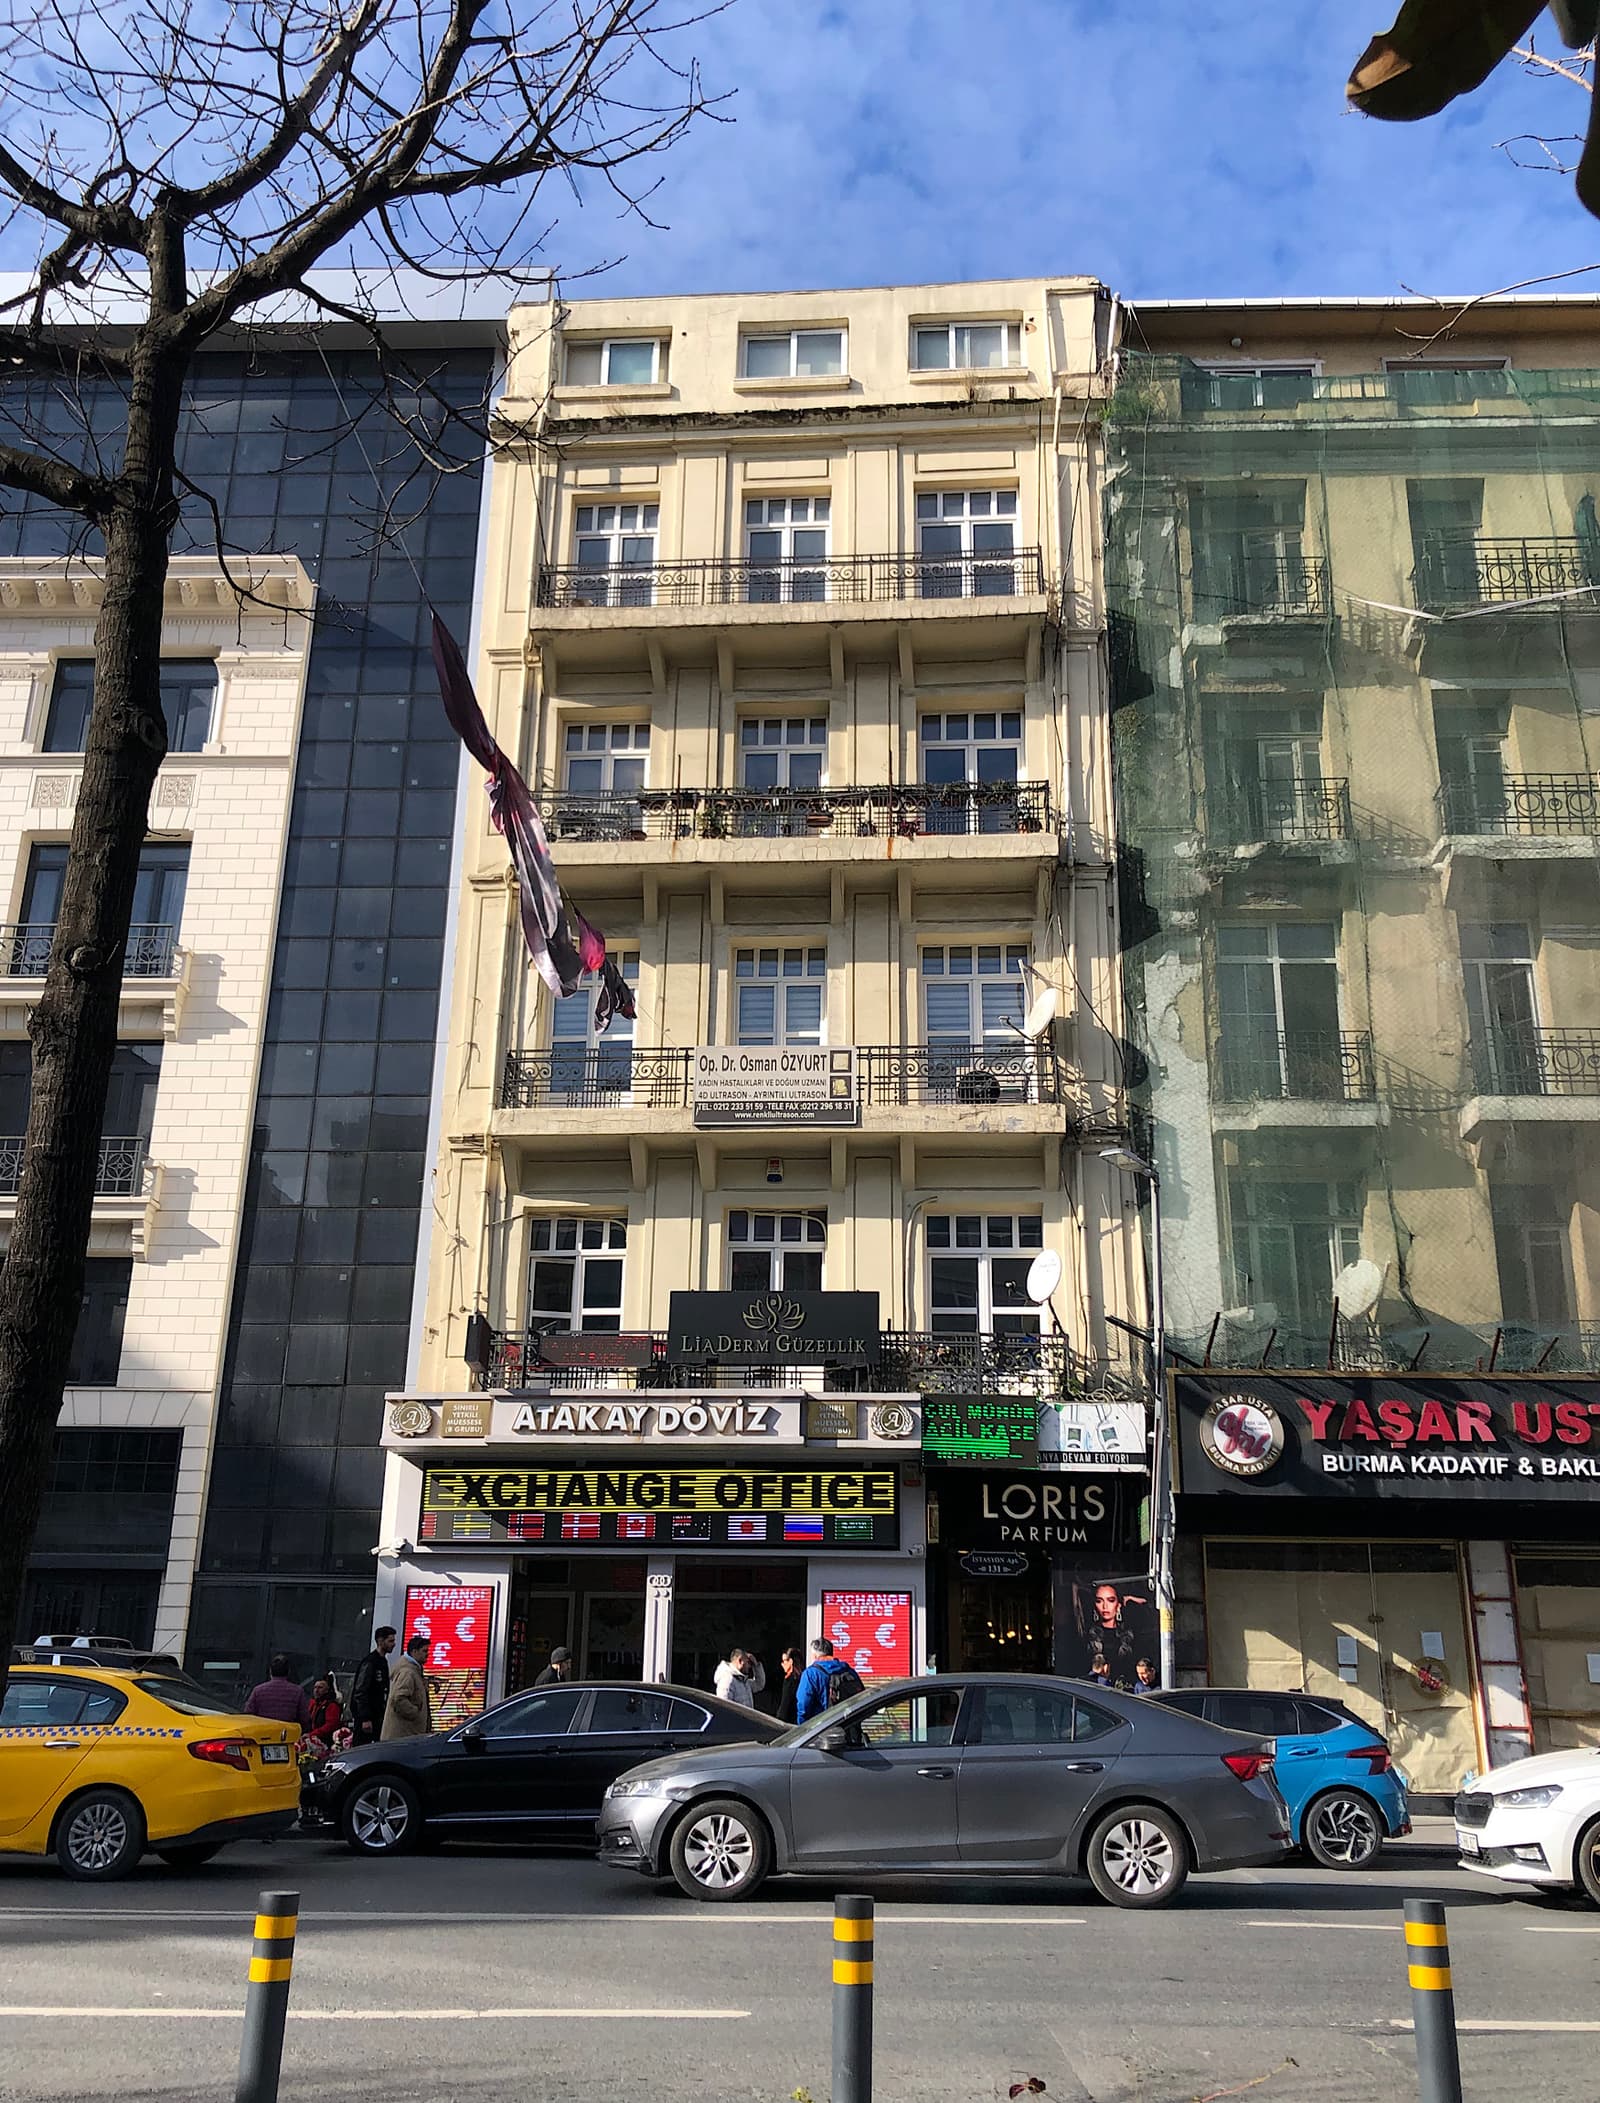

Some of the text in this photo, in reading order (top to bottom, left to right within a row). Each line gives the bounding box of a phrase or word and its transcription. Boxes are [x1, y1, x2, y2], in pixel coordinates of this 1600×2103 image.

[699, 1050, 828, 1076] Op. Dr. Osman ÖZYURT
[698, 1077, 827, 1087] KADIN HASTALIKLARI VE DOĞUM UZMANI
[698, 1091, 709, 1100] 4D
[709, 1091, 748, 1100] ULTRASON
[753, 1091, 788, 1099] AYRINTILI
[788, 1091, 828, 1099] ULTRASON
[713, 1102, 730, 1111] 0212
[730, 1102, 744, 1111] 233
[745, 1102, 753, 1110] 51
[754, 1102, 764, 1110] 59
[785, 1102, 800, 1110] FAX
[820, 1102, 834, 1110] 296
[843, 1102, 852, 1110] 31
[512, 1398, 770, 1433] ATAKAY DÖVİZ
[1247, 1396, 1275, 1419] USTA
[1296, 1399, 1497, 1448] YAŞAR
[1062, 1453, 1092, 1464] DEVAM
[1208, 1444, 1241, 1473] BURMA
[1322, 1454, 1406, 1474] BURMA
[1411, 1455, 1509, 1475] KADAYIF
[1518, 1456, 1536, 1476] &
[430, 1473, 892, 1510] EXCHANGE OFFICE
[982, 1484, 1105, 1522] LORIS
[1001, 1526, 1088, 1543] PARFUM
[409, 1588, 488, 1600] EXCHANGE
[825, 1593, 909, 1606] EXCHANGE
[422, 1600, 476, 1611] OFFICE
[839, 1605, 894, 1617] OFFICE
[830, 1620, 897, 1652] $ €
